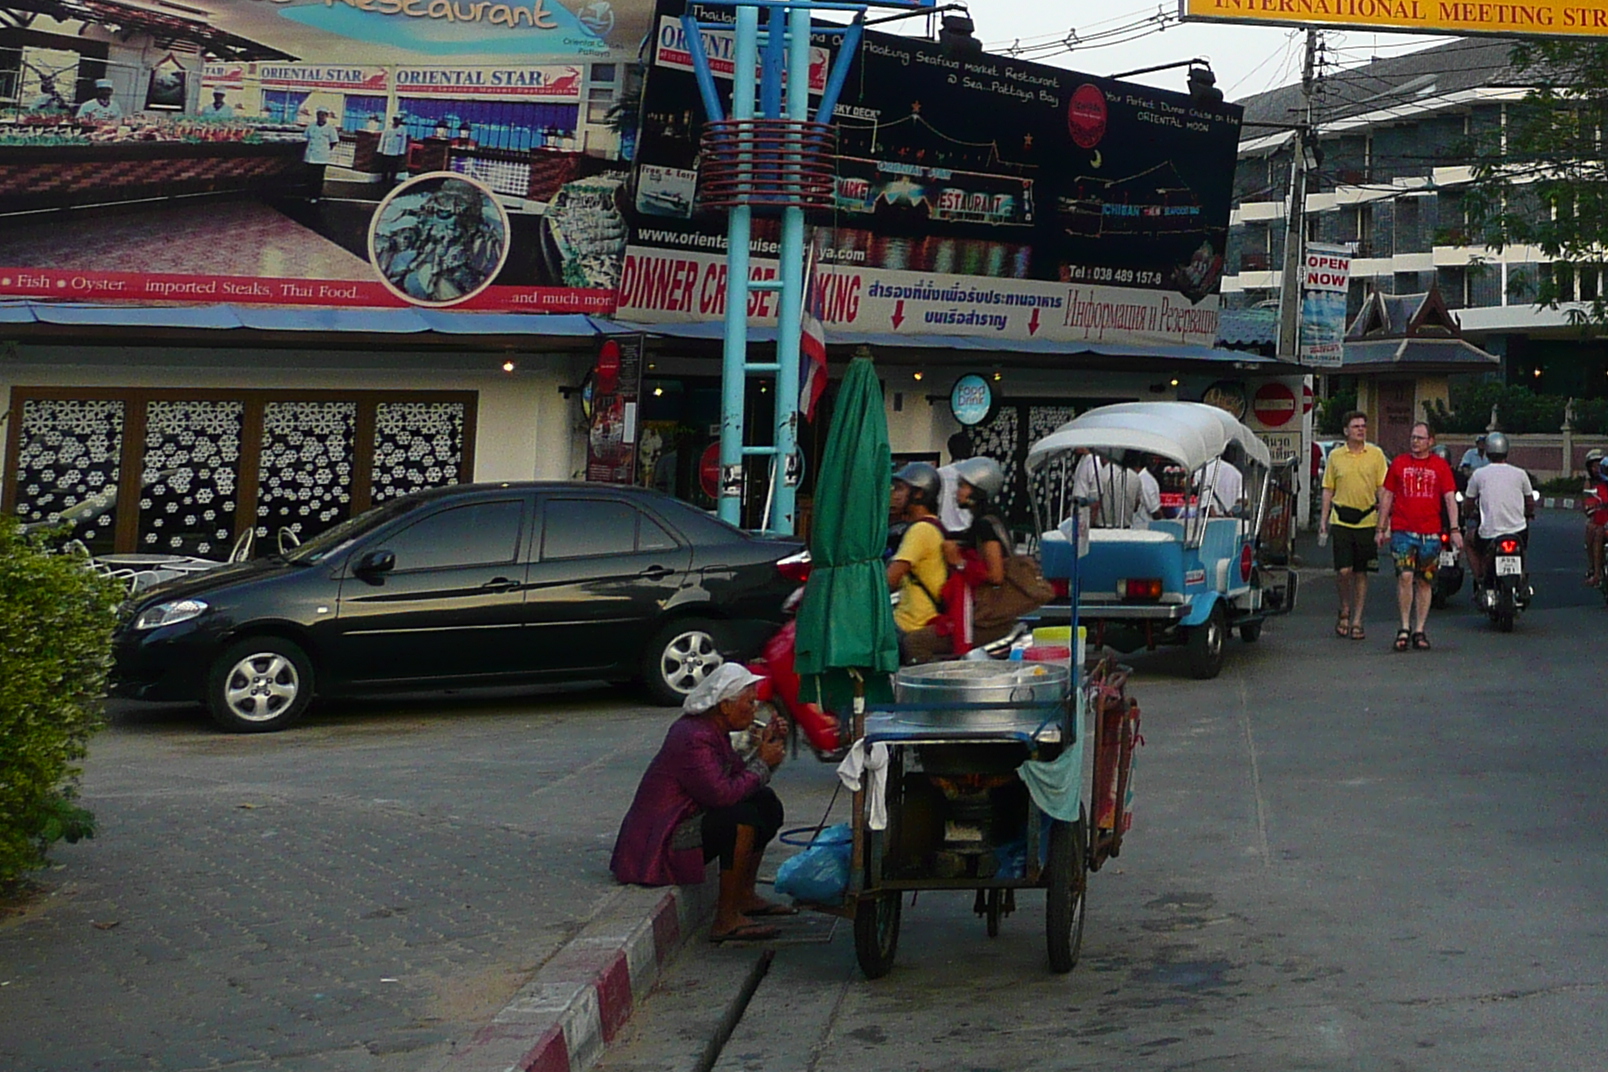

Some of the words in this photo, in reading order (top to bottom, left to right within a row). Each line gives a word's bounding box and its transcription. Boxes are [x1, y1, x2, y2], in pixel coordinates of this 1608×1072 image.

[1438, 2, 1553, 27] MEETING
[261, 68, 323, 82] ORIENTAL
[328, 71, 363, 84] STAR
[396, 70, 486, 86] ORIENTAL
[490, 71, 543, 87] STAR
[1005, 66, 1061, 89] Restaurant
[1039, 90, 1060, 108] Bay
[1137, 111, 1184, 129] ORIENTAL
[1307, 256, 1349, 270] OPEN
[1069, 264, 1085, 276] Tel
[1093, 265, 1113, 278] 038
[1114, 268, 1133, 282] 489
[1135, 271, 1162, 285] 157-8
[1307, 273, 1345, 287] NOW
[16, 273, 50, 289] Fish
[145, 278, 217, 296] imported
[222, 281, 274, 298] Steaks,
[281, 283, 313, 297] Thai
[618, 255, 698, 313] DINNER
[700, 262, 775, 317] CRSE
[542, 292, 579, 305] much
[924, 308, 1007, 330] บนเรือสำราญ
[1063, 288, 1147, 339] Информация
[958, 384, 986, 396] Food
[958, 393, 985, 406] Drink
